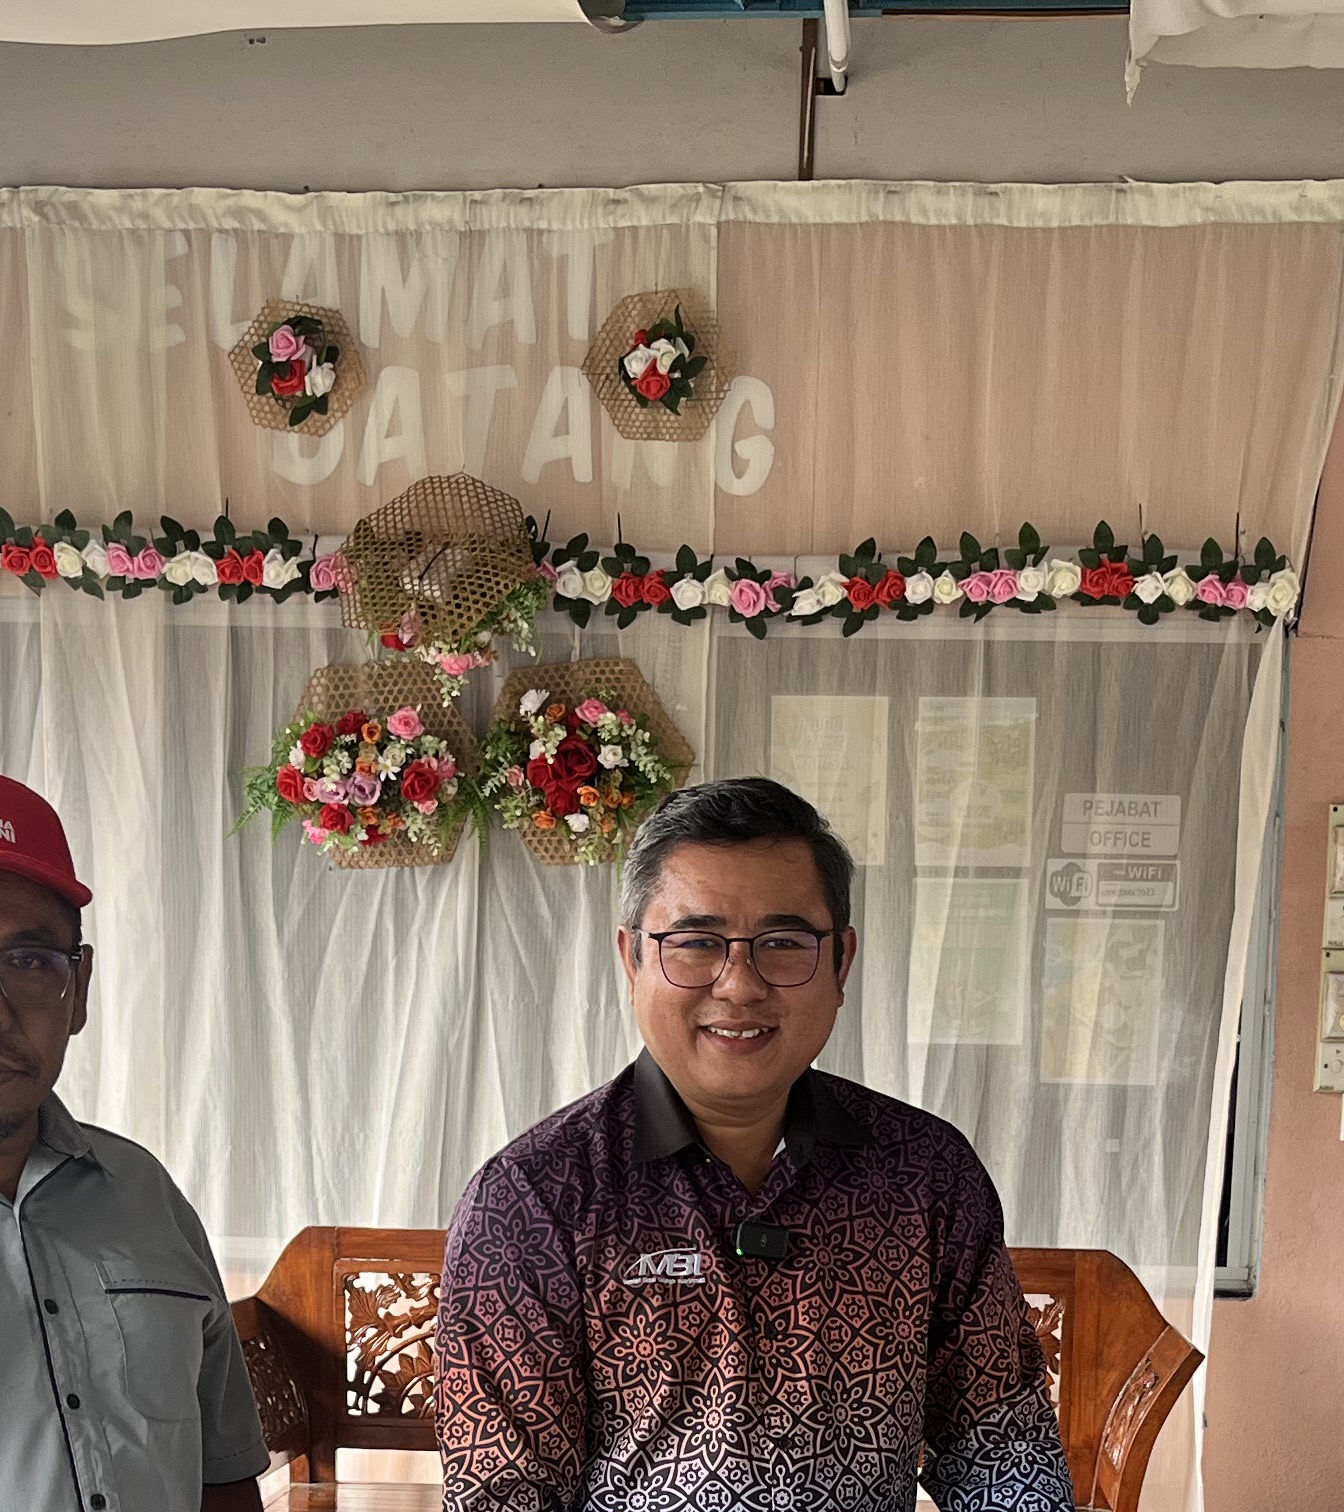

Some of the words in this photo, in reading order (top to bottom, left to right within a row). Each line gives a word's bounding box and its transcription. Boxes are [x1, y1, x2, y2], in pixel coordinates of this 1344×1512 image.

[1083, 800, 1161, 818] PEJABAT
[1090, 831, 1151, 848] OFFICE
[1128, 866, 1162, 880] WiFi
[1052, 875, 1089, 893] WiFi
[639, 1253, 703, 1277] MBI
